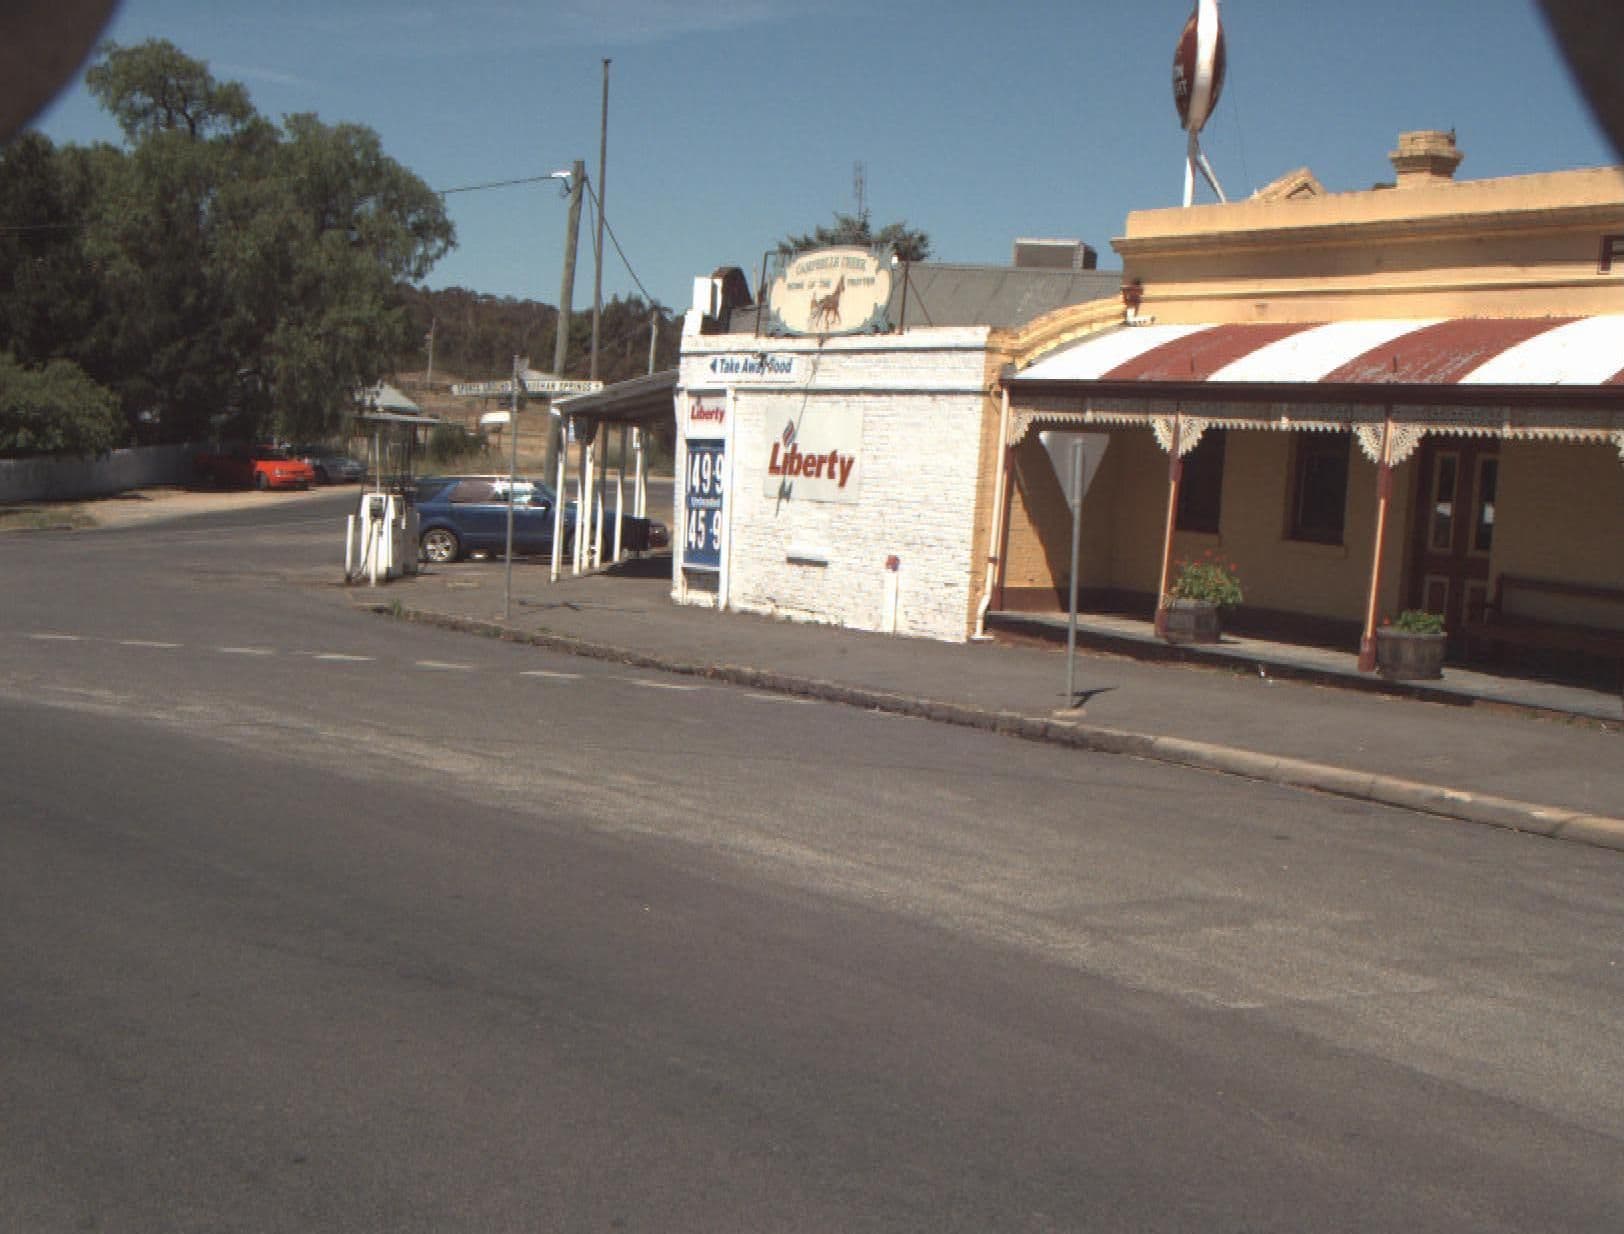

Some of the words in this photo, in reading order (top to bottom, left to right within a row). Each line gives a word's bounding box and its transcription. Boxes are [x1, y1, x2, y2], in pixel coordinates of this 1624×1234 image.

[720, 358, 740, 373] Take
[742, 358, 767, 376] Away
[691, 405, 725, 423] Liberty
[768, 442, 855, 488] Liberty
